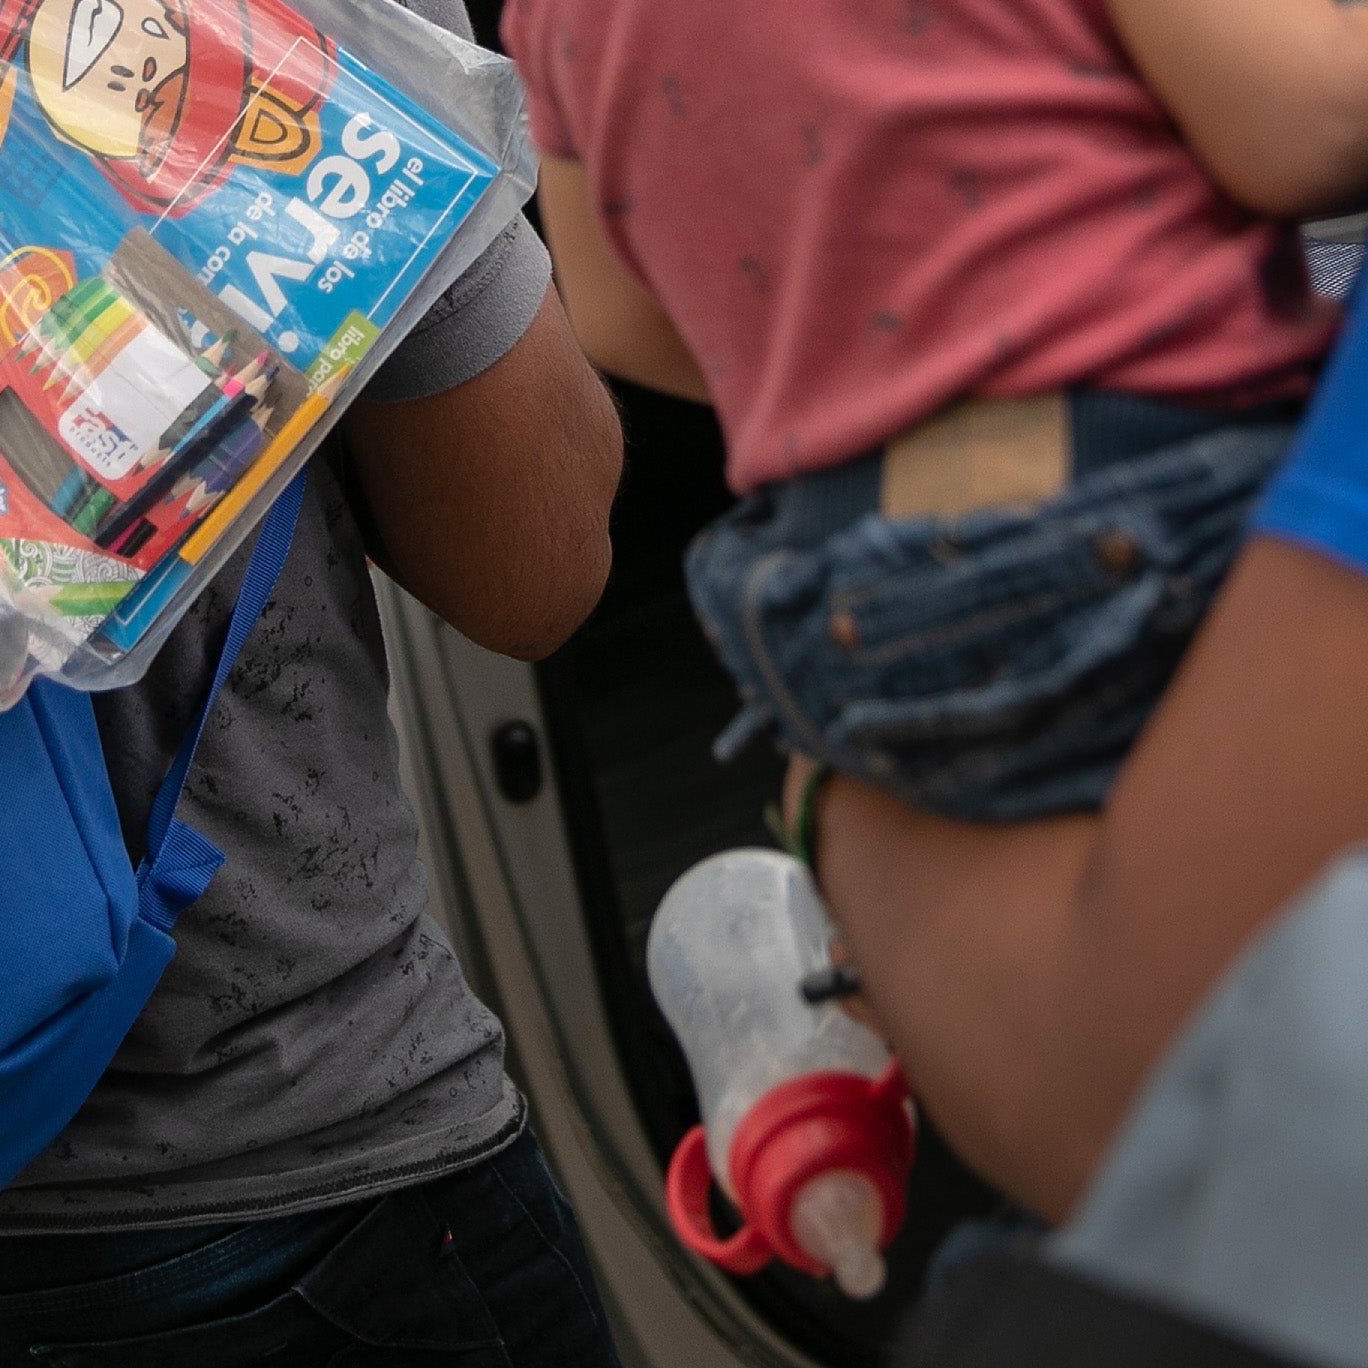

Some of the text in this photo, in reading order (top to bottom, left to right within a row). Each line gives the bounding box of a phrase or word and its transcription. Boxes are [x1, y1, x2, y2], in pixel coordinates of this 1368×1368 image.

[246, 191, 276, 222] de
[218, 111, 401, 353] servi
[227, 221, 259, 246] la
[317, 157, 424, 294] el libro de los
[330, 325, 365, 361] libro
